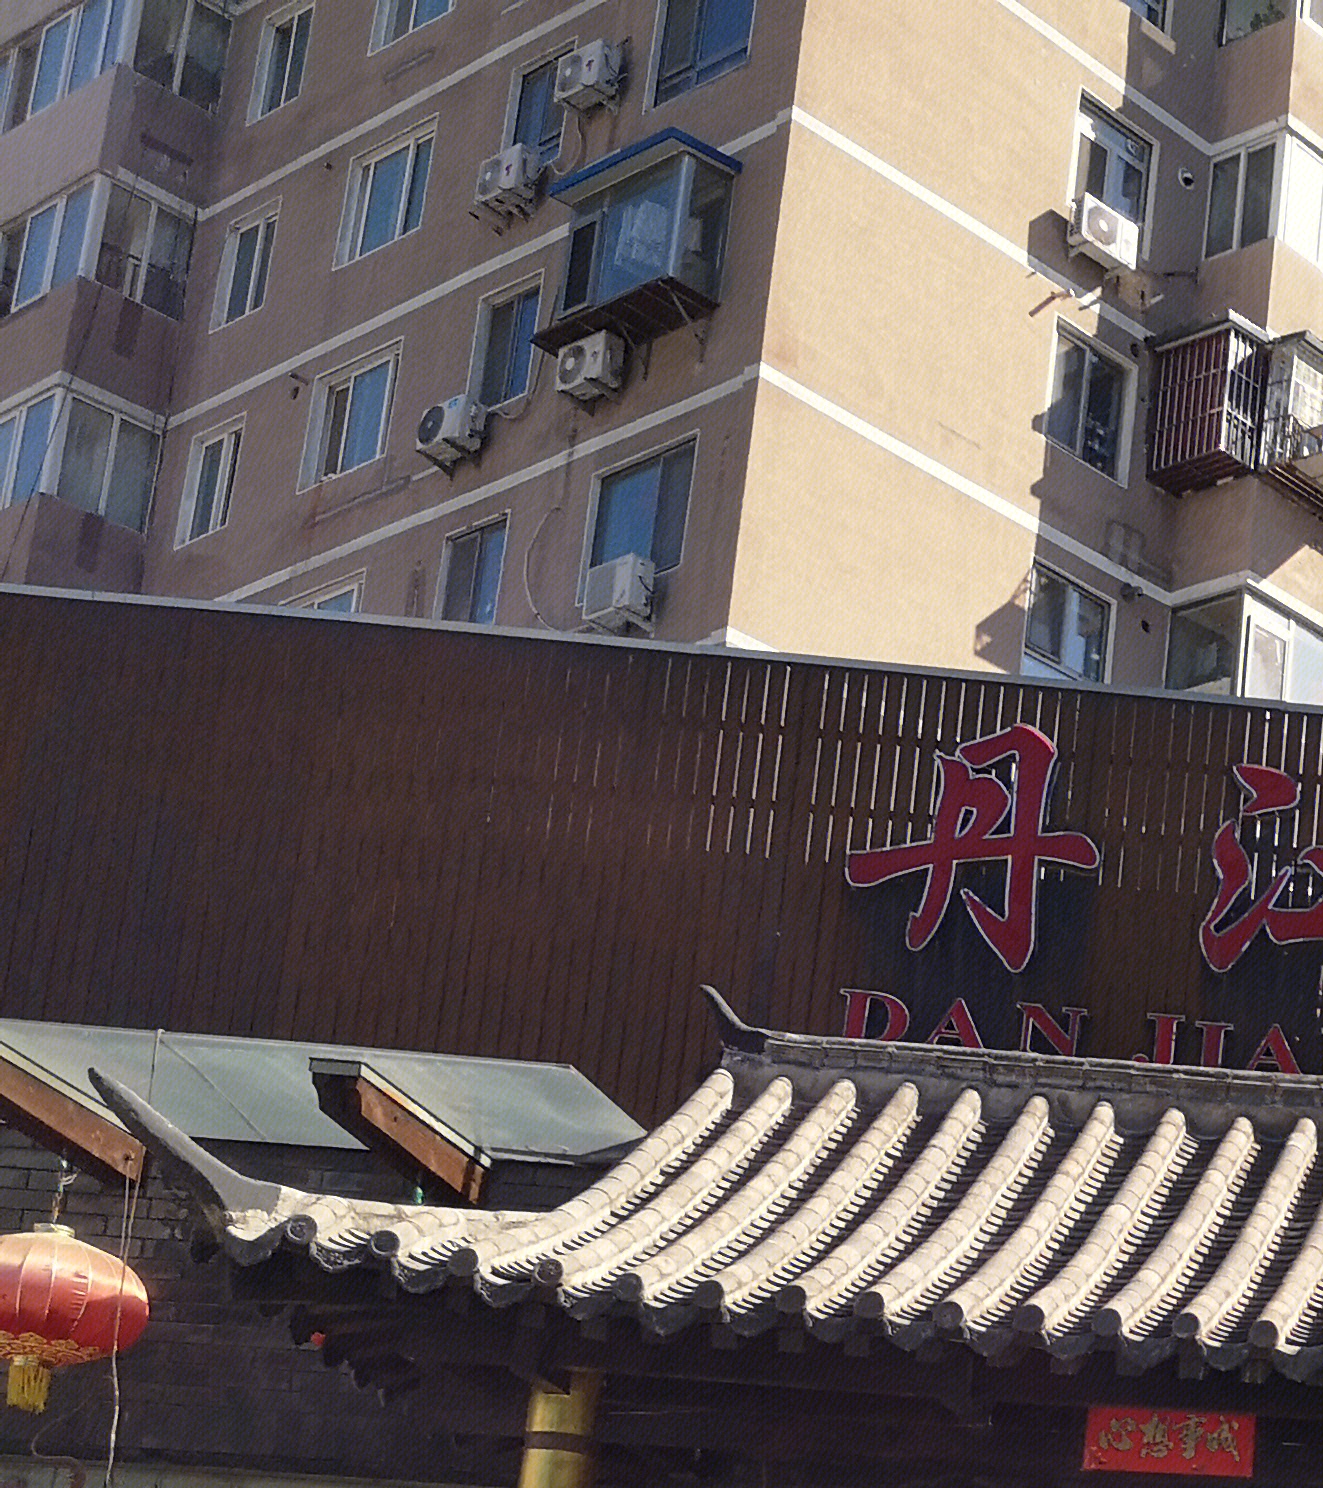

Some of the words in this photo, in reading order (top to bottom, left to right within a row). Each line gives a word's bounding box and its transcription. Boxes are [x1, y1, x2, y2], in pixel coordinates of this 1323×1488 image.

[840, 988, 1088, 1056] DAN
[1098, 1413, 1240, 1462] 心想事成
